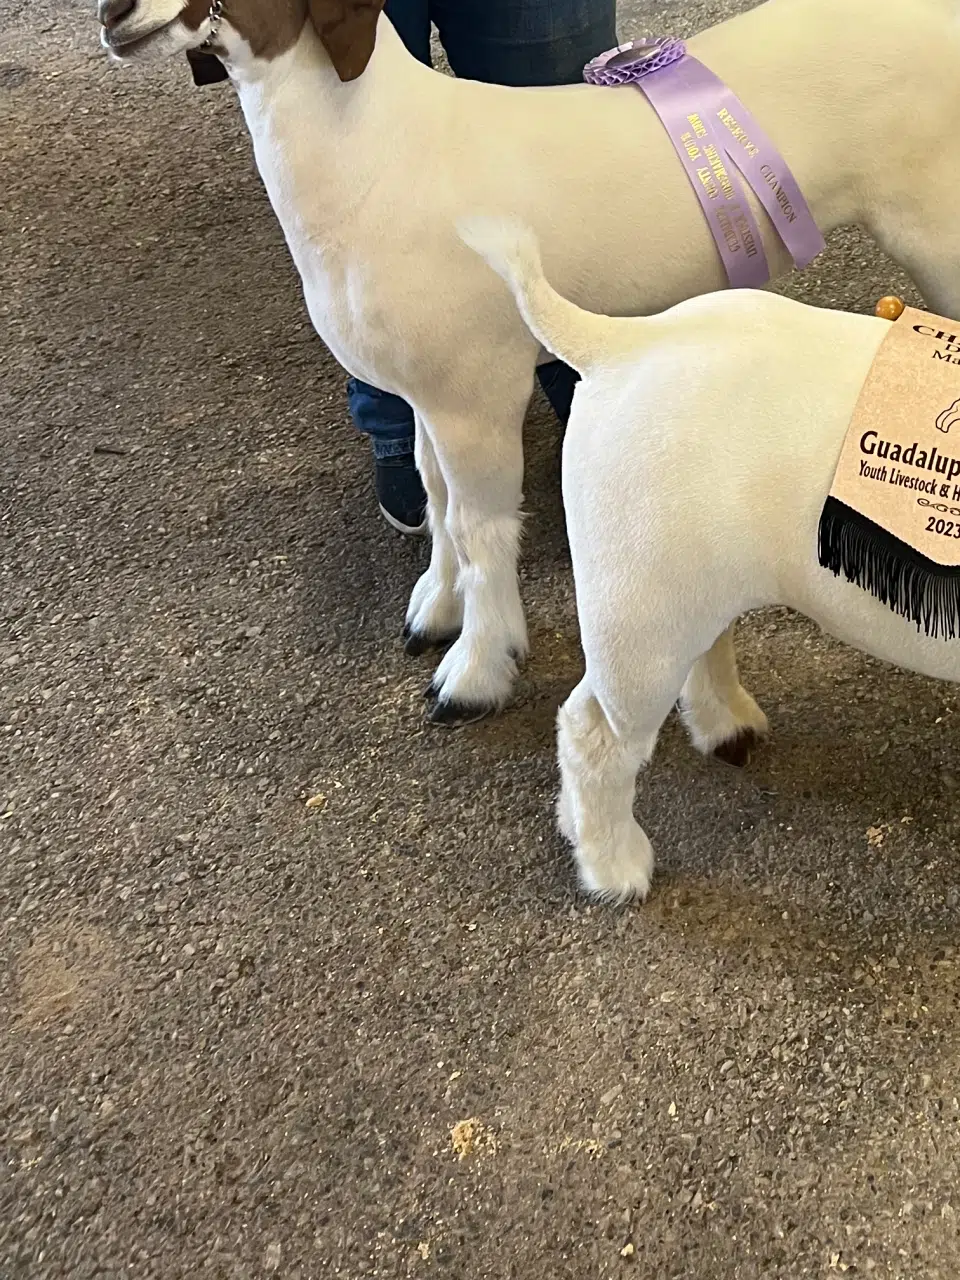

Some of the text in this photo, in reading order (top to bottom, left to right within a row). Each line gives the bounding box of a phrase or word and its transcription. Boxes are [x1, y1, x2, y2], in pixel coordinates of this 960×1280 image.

[760, 164, 797, 224] CHAMPION
[859, 459, 888, 483] Youth
[889, 467, 937, 495] Livestock
[939, 484, 950, 499] &
